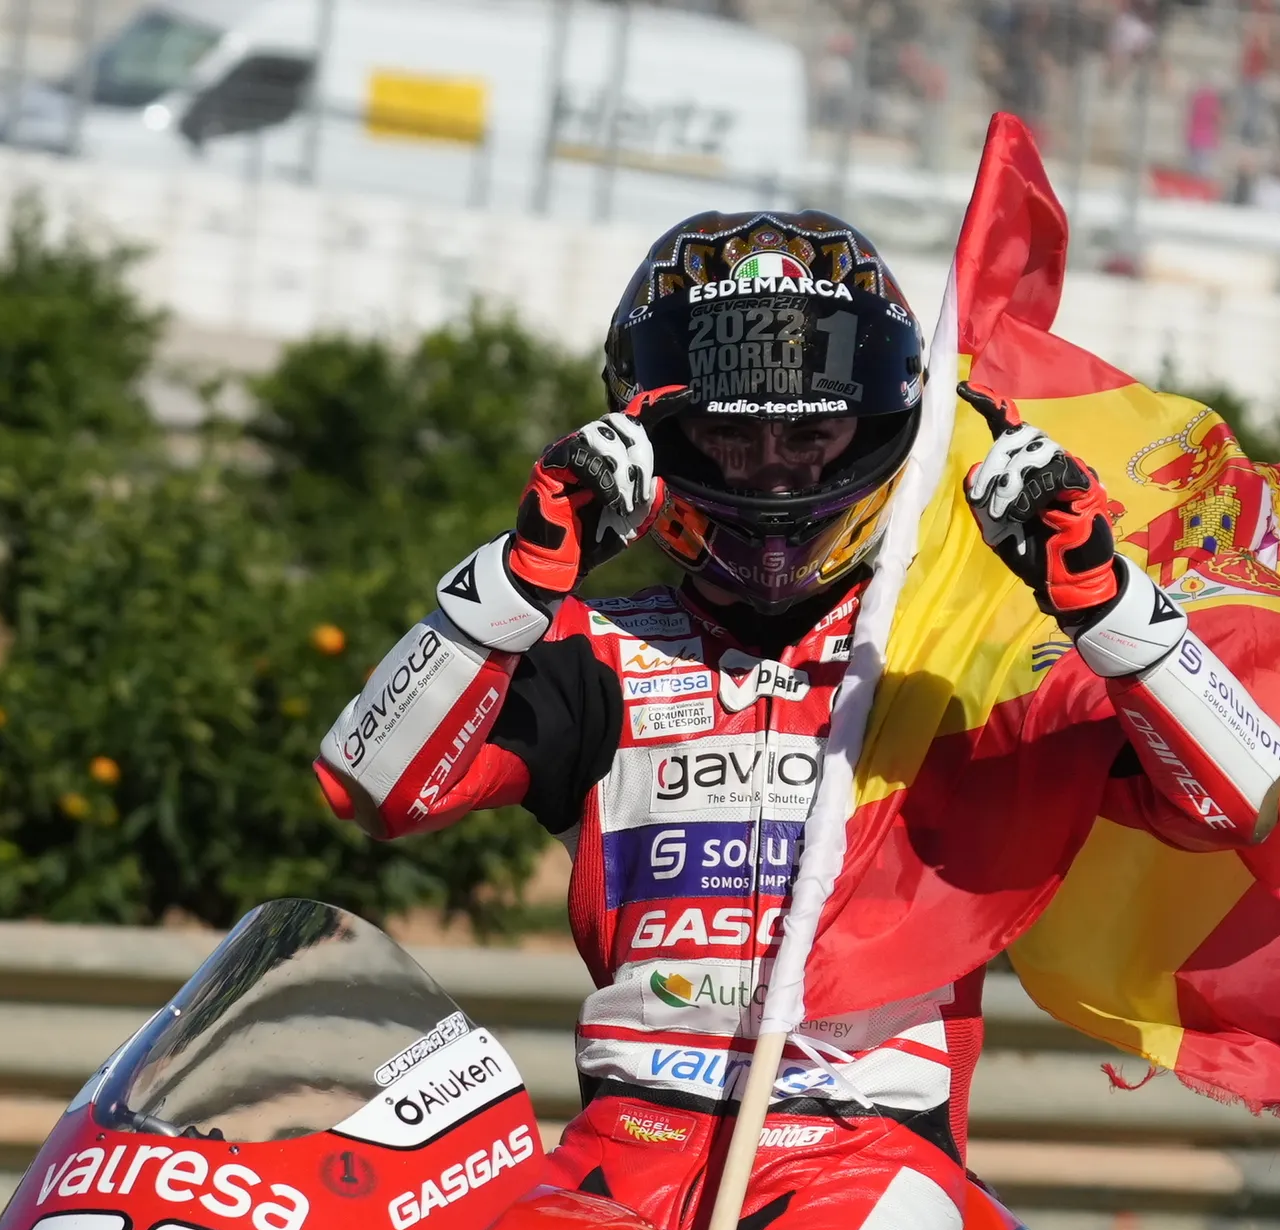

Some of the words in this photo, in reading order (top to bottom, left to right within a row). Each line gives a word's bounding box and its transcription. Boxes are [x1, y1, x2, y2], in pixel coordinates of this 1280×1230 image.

[688, 276, 853, 303] ESDEMARCA
[692, 299, 771, 317] GUEVARA
[688, 308, 805, 351] 2022
[688, 341, 803, 378] WORLD
[689, 368, 803, 404] CHAMPION
[707, 398, 848, 414] audio-technica
[728, 559, 820, 588] solunion
[616, 614, 685, 628] AutoSolar
[344, 630, 442, 769] gaviota
[374, 730, 388, 746] The
[384, 716, 397, 733] Sun
[398, 686, 419, 713] Shutter
[417, 650, 450, 689] Specialists
[649, 708, 705, 721] COMUNITAT
[654, 721, 665, 730] DE
[668, 716, 712, 728] L'ESPORT
[1203, 689, 1228, 718] SOMOS
[1228, 716, 1256, 751] IMPULSO
[406, 686, 499, 821] DAINESE
[1121, 707, 1236, 829] DAINESE
[657, 751, 824, 800] gavio
[707, 794, 726, 803] The
[730, 792, 753, 803] Sun
[755, 791, 761, 801] &
[701, 876, 749, 889] SOMOS
[339, 1151, 358, 1184] 1
